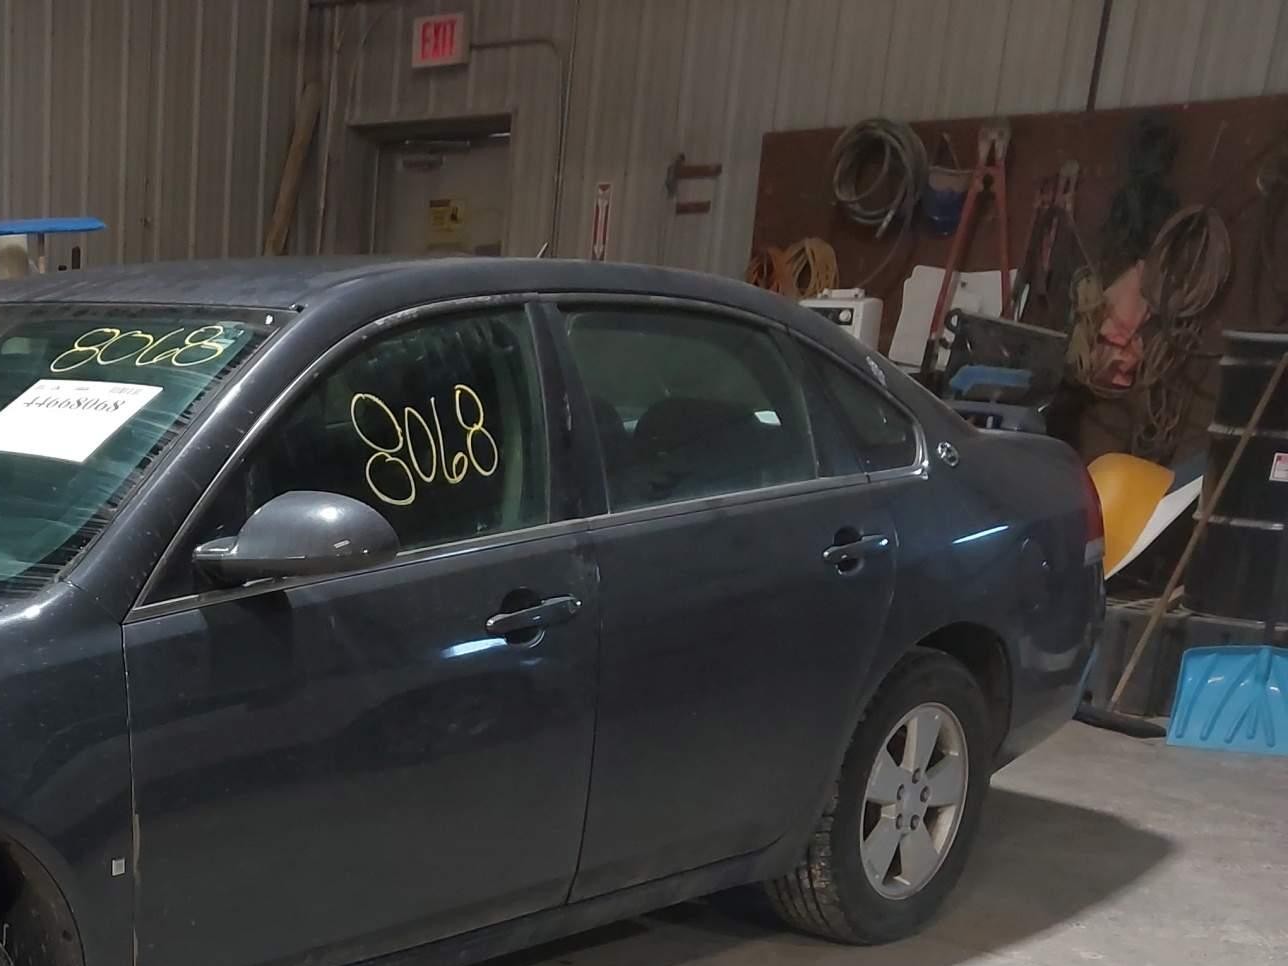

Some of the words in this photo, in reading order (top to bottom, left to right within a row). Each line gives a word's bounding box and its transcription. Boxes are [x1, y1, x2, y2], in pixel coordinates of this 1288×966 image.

[421, 21, 456, 60] EXIT
[50, 326, 224, 373] 8068
[23, 395, 126, 413] 44668068
[350, 384, 499, 506] 8068
